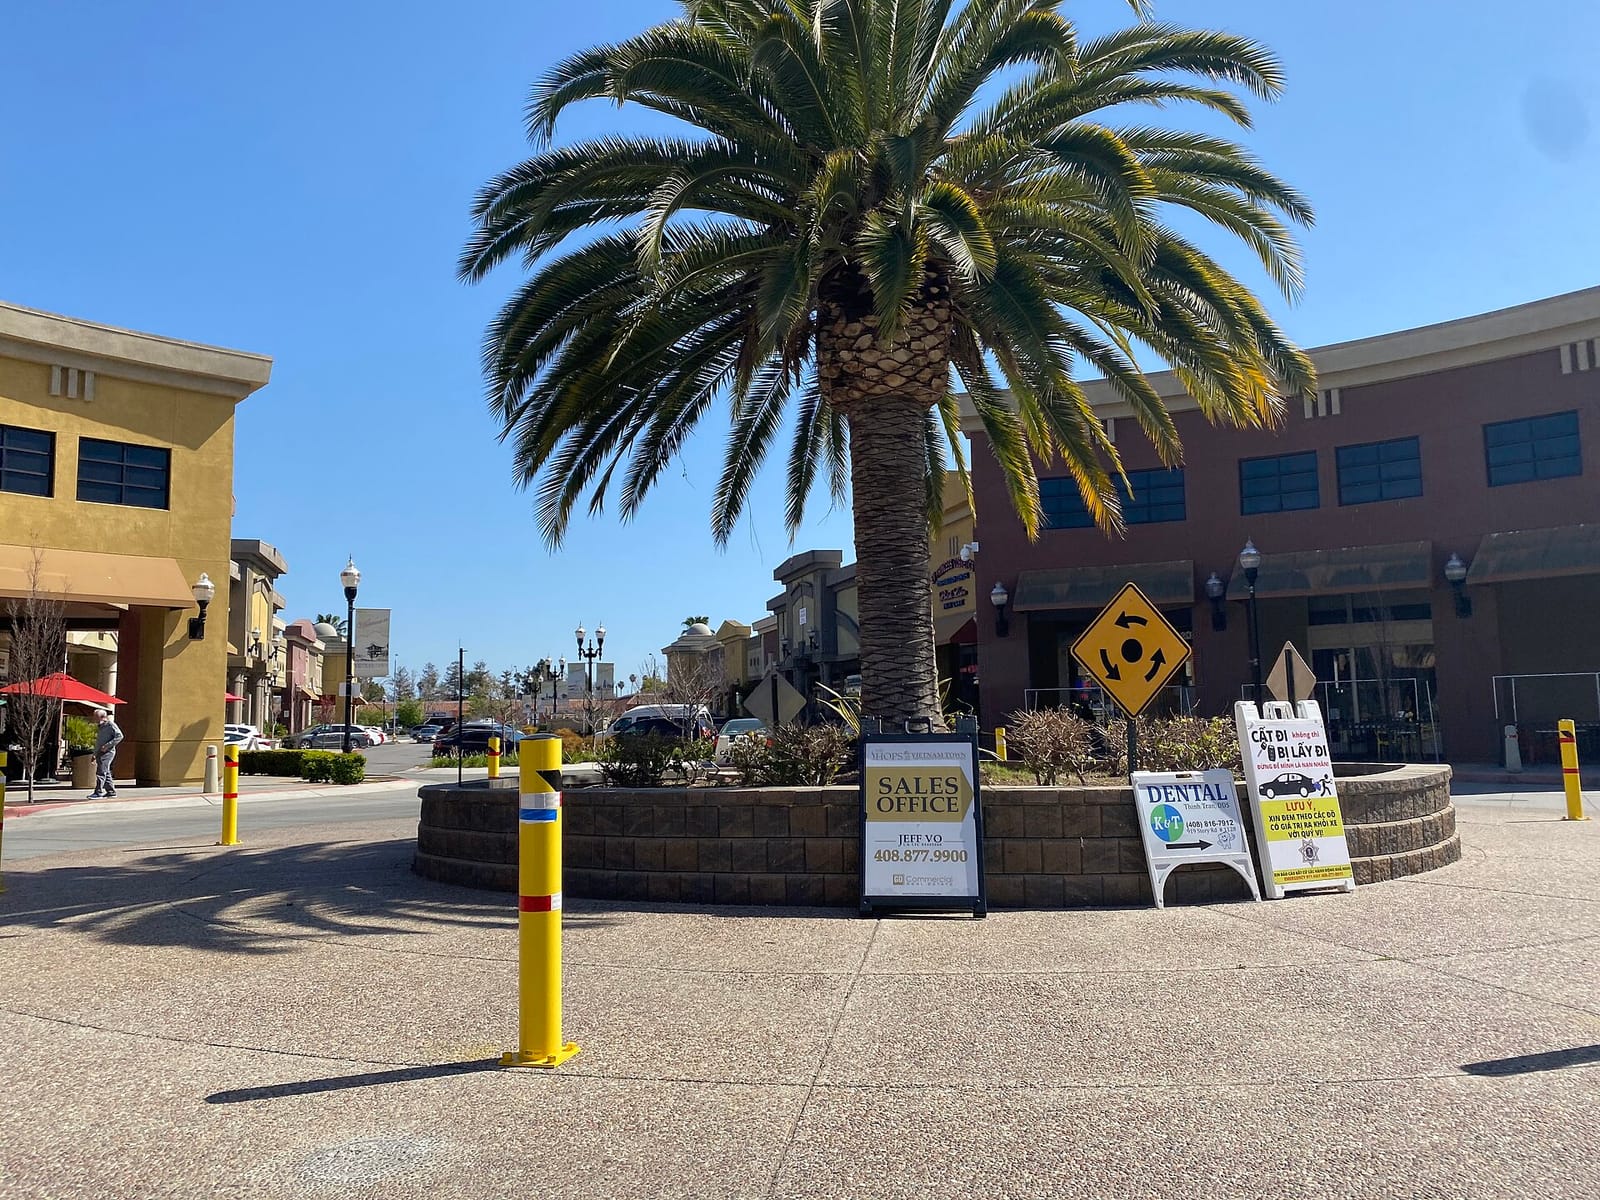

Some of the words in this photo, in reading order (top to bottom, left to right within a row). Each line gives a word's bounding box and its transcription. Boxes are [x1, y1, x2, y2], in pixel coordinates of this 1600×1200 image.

[1251, 726, 1273, 743] CẤT
[1275, 729, 1288, 742] ĐI
[1292, 731, 1310, 739] không
[1277, 746, 1290, 762] BỊ
[1291, 741, 1312, 758] LẤY
[1315, 745, 1328, 757] ĐI
[878, 776, 959, 795] SALES
[1146, 784, 1228, 803] DENTAL
[876, 796, 959, 813] OFFICE
[1286, 802, 1305, 812] LƯU
[1314, 810, 1325, 818] CÁC
[1186, 820, 1202, 828] (408)
[1270, 822, 1280, 830] CÓ
[1280, 821, 1292, 830] GIÁ
[1293, 822, 1302, 830] TRỊ
[1288, 830, 1300, 838] VỚI
[1301, 829, 1314, 838] QUÝ
[898, 834, 922, 847] JEFF
[924, 834, 942, 843] VO
[874, 849, 968, 862] 408.877.9900
[906, 875, 953, 883] Commercial
